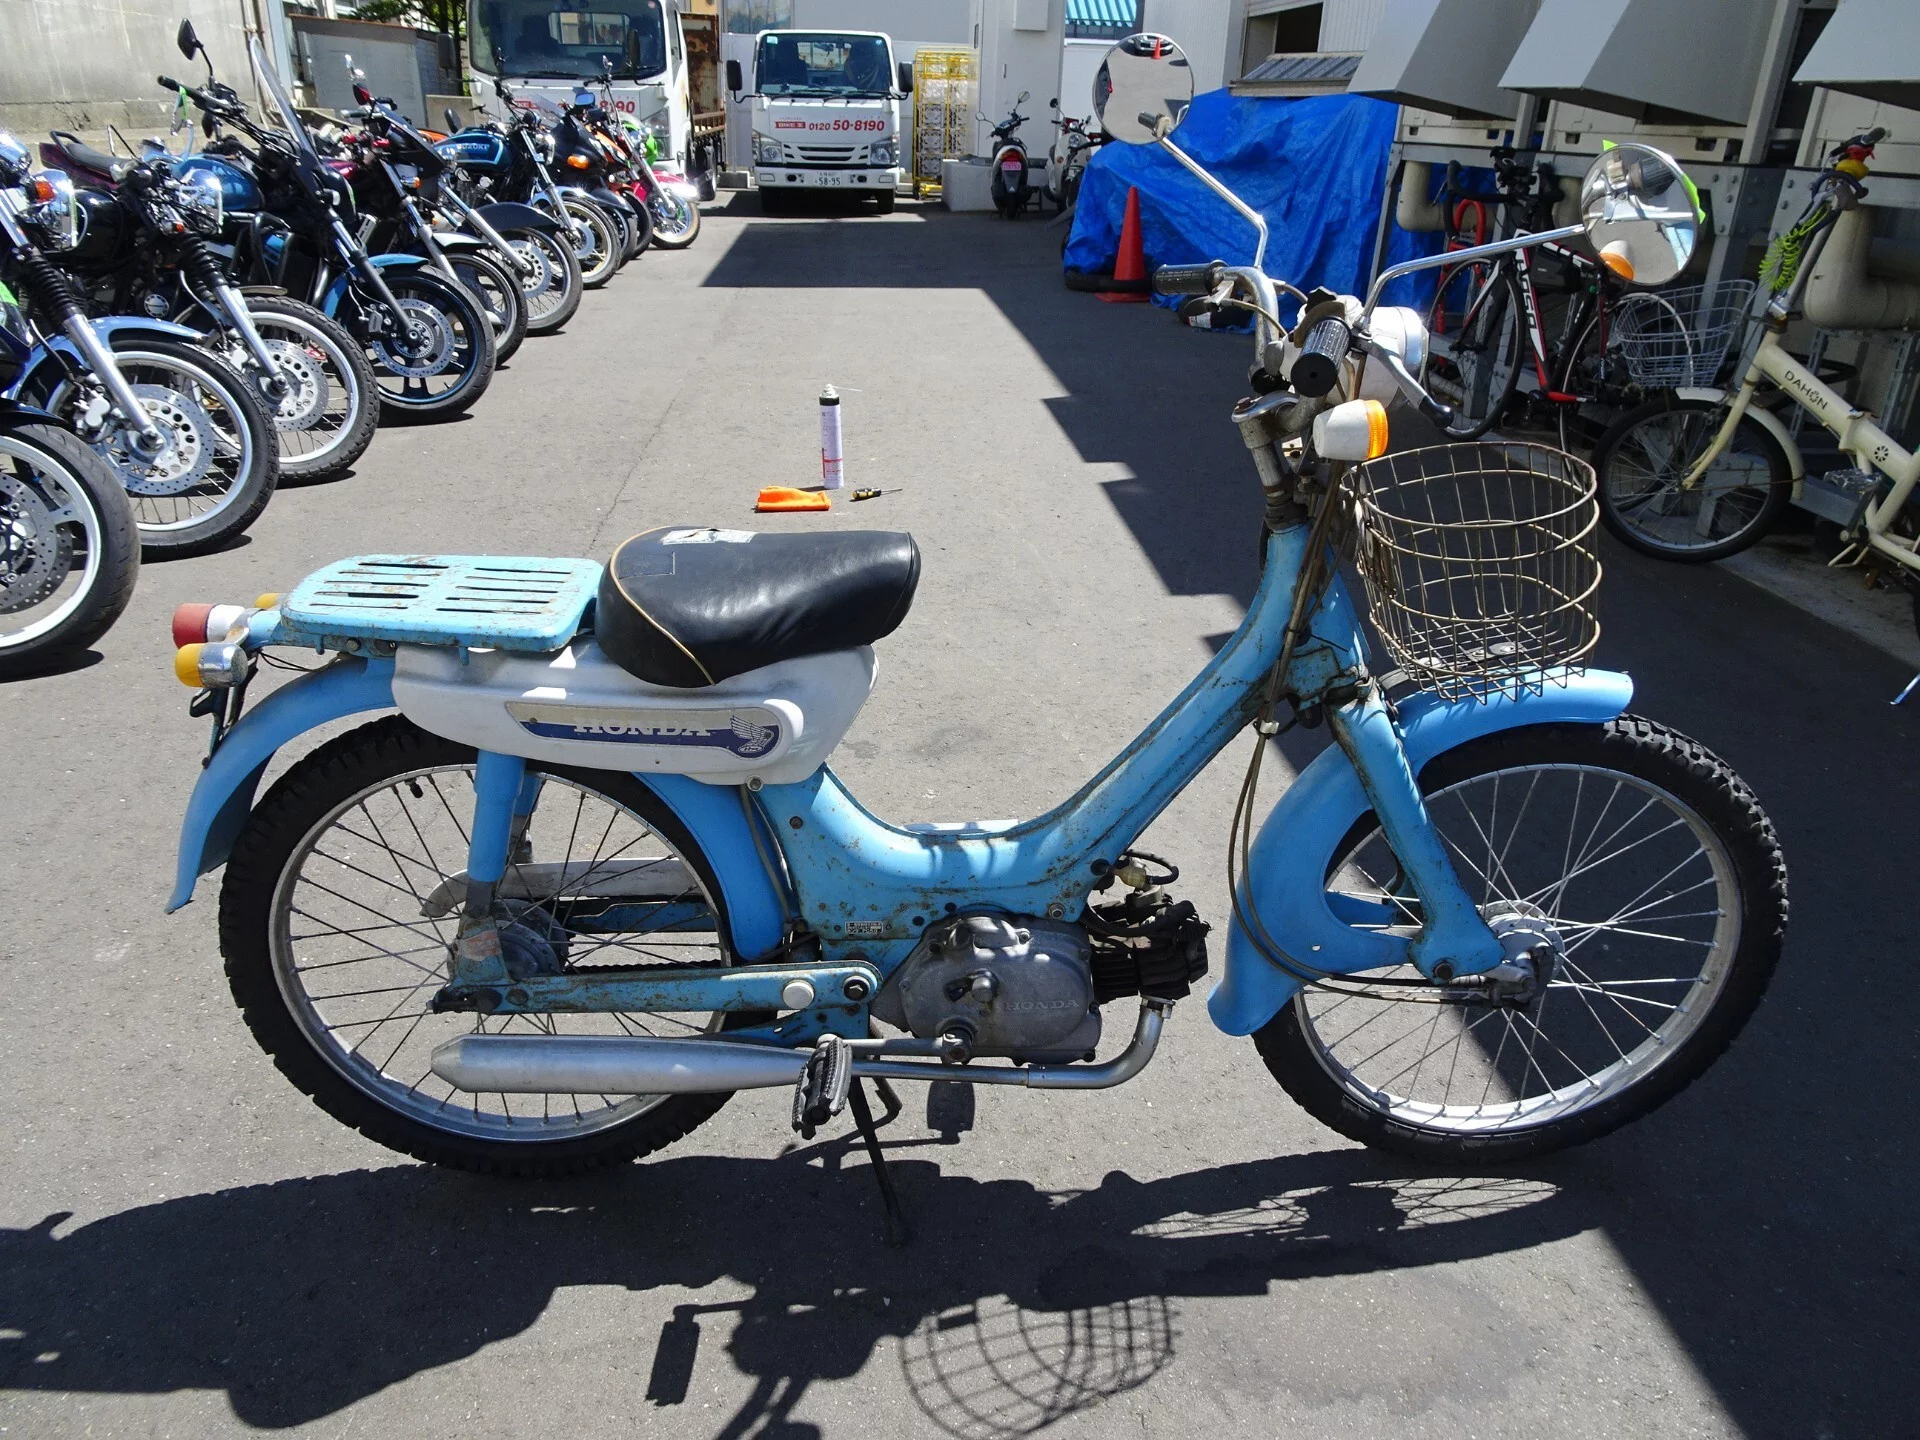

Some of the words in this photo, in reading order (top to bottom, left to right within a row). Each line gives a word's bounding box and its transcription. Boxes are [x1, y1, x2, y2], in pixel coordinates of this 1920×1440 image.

[808, 122, 831, 131] 0120
[1784, 370, 1829, 410] DAHON
[572, 717, 712, 737] HONDA
